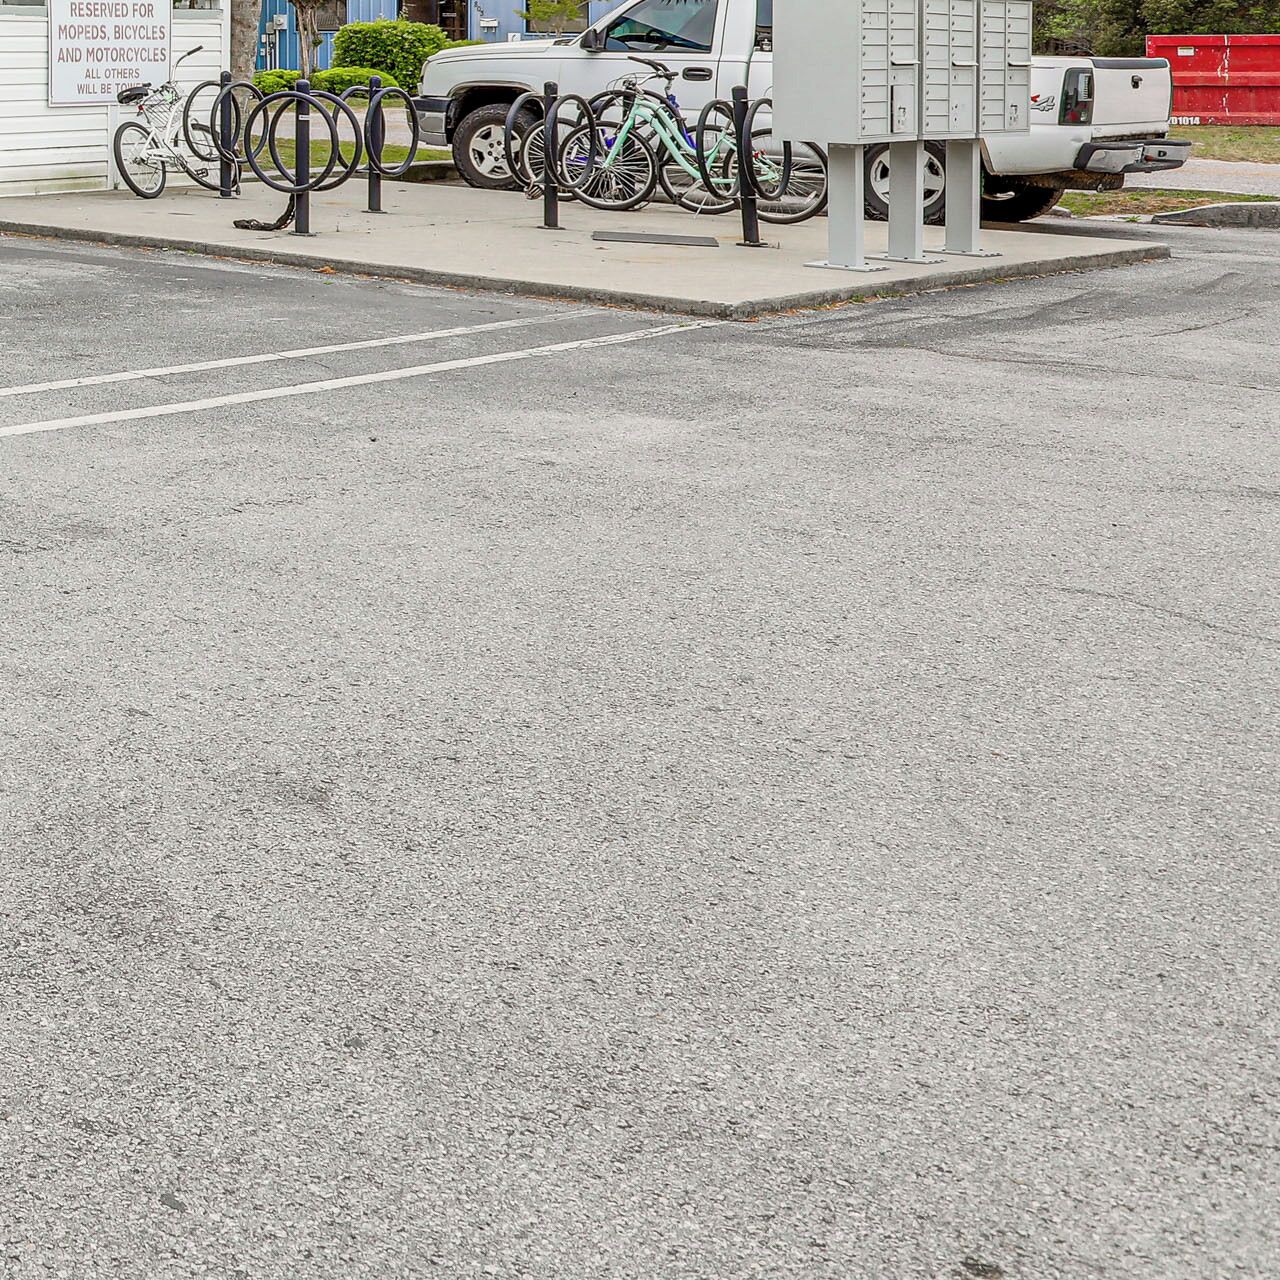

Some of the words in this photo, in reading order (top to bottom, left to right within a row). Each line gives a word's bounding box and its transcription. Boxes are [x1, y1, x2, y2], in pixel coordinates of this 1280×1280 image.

[70, 2, 129, 18] RESERVED
[132, 3, 154, 18] FOR
[58, 25, 110, 41] MOPEDS,
[114, 25, 165, 40] BICYCLES
[57, 48, 82, 63] AND
[86, 48, 167, 63] MOTORCYCLES
[85, 68, 101, 79] ALL
[104, 68, 140, 79] OTHERS
[77, 83, 98, 94] WILL
[100, 83, 112, 94] BE
